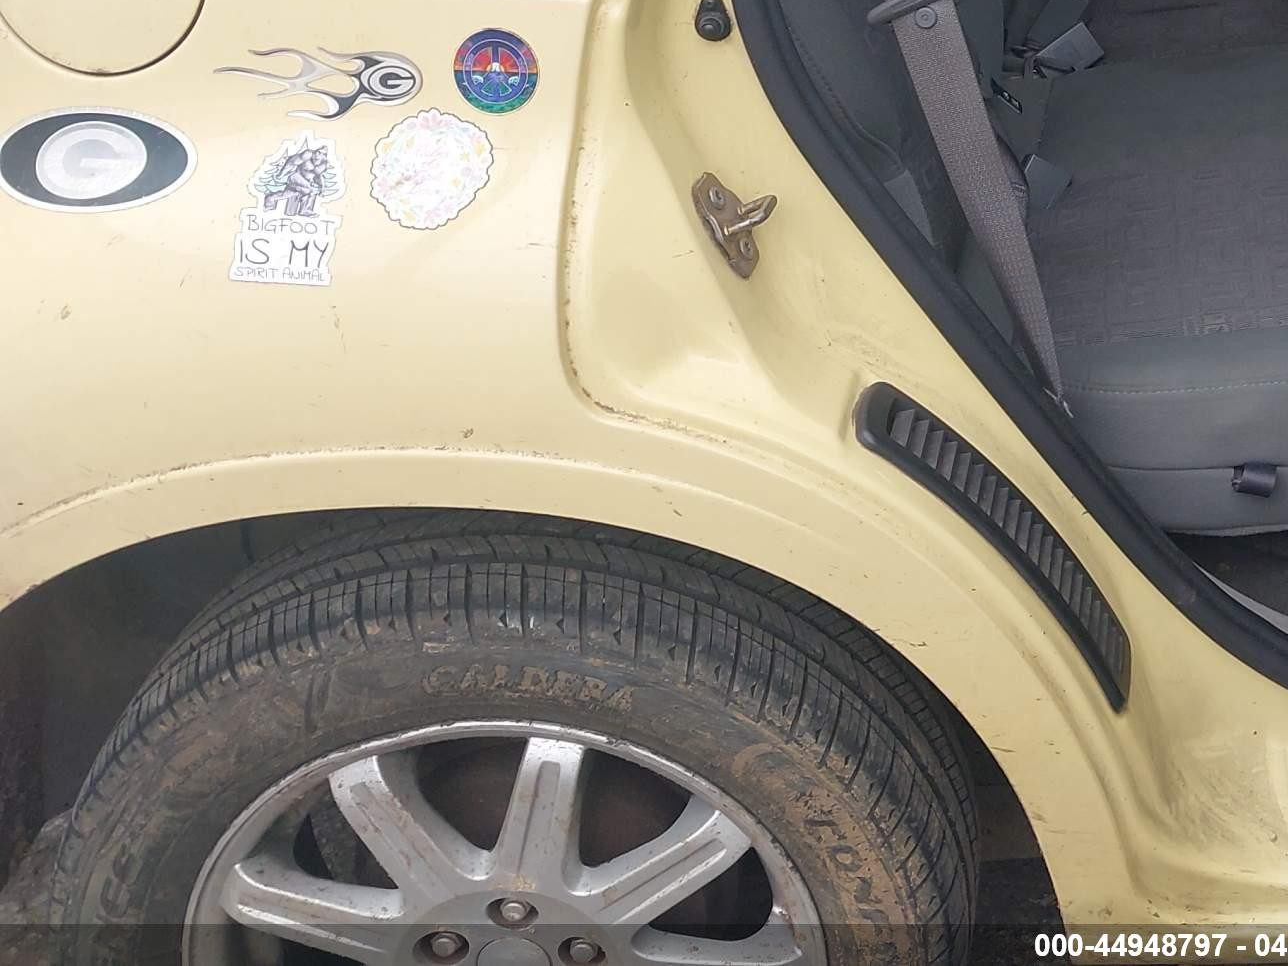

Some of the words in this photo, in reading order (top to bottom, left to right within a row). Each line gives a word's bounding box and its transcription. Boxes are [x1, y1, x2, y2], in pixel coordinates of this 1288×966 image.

[367, 65, 416, 97] G
[38, 121, 147, 200] G
[246, 213, 336, 235] BIGFOOT
[239, 237, 271, 265] IS
[288, 239, 330, 269] MY
[234, 266, 280, 279] SPIRIT
